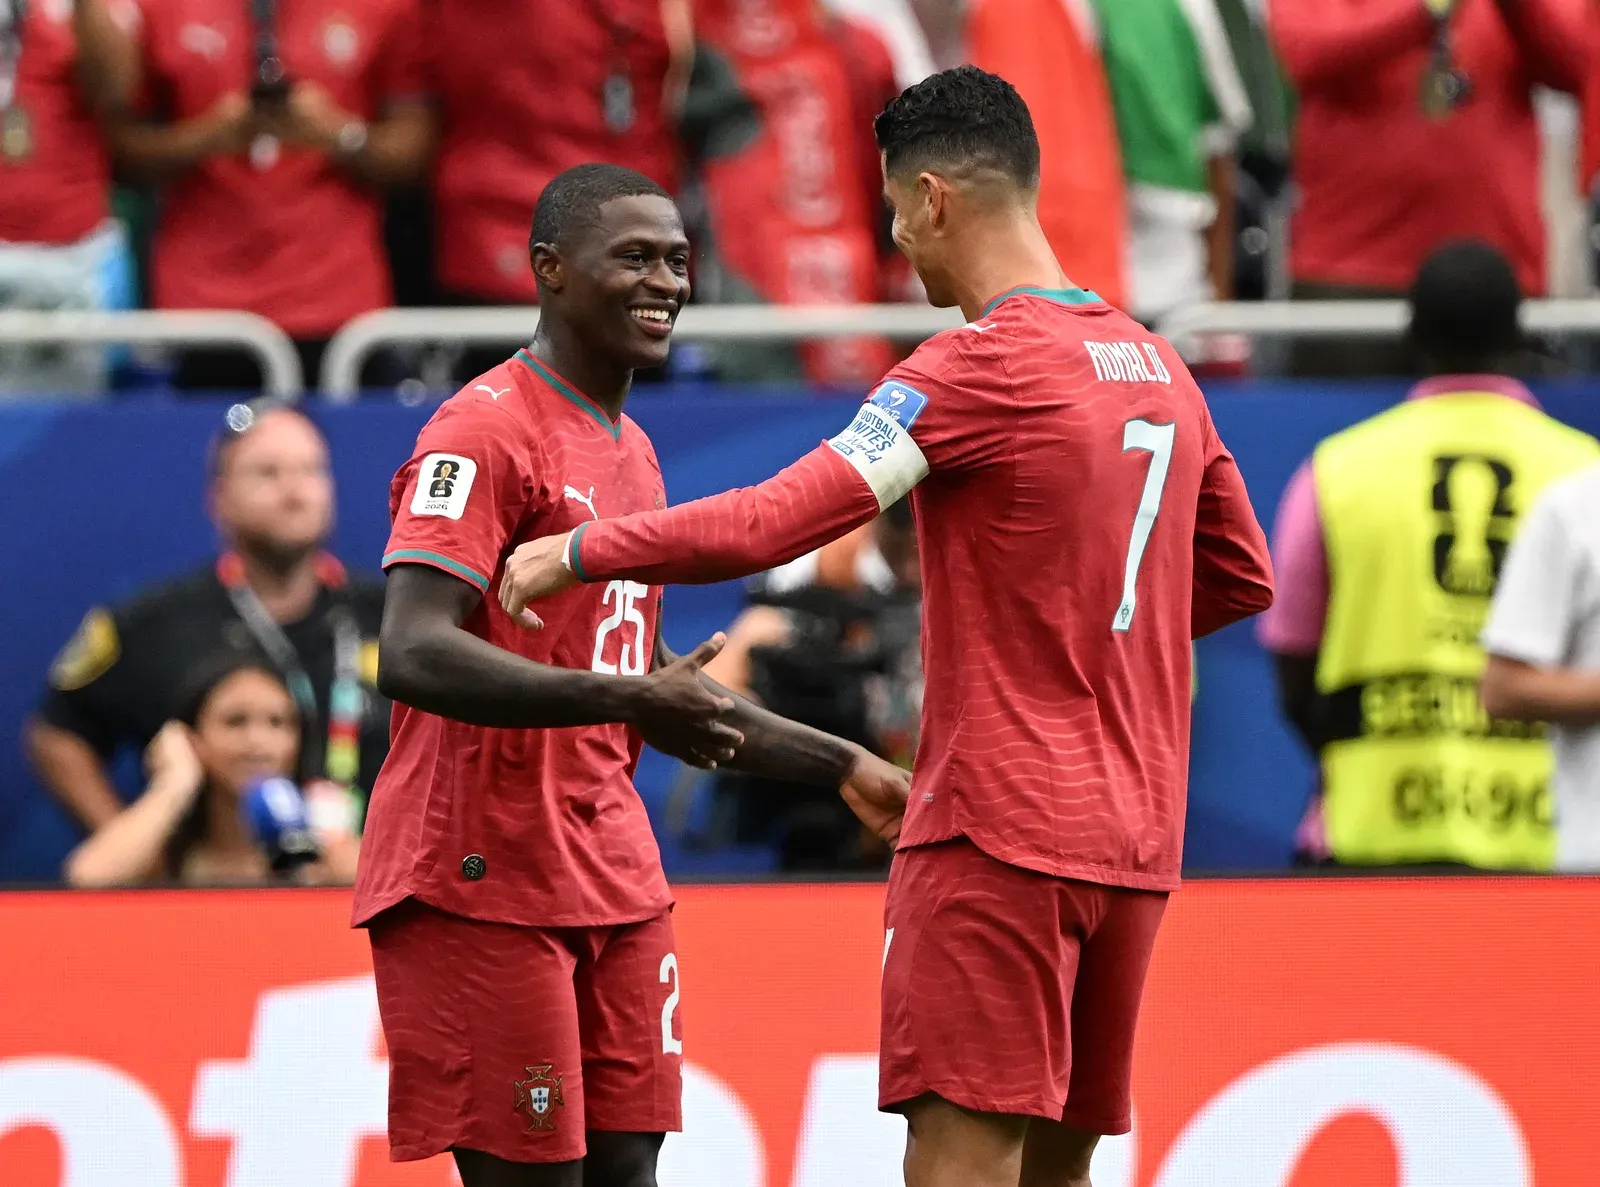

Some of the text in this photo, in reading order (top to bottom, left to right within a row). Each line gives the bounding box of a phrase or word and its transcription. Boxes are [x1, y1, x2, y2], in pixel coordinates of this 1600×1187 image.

[847, 436, 882, 464] World
[860, 409, 898, 444] FOOTBALL
[1111, 417, 1177, 632] 7
[592, 579, 648, 676] 25
[659, 952, 683, 1056] 2
